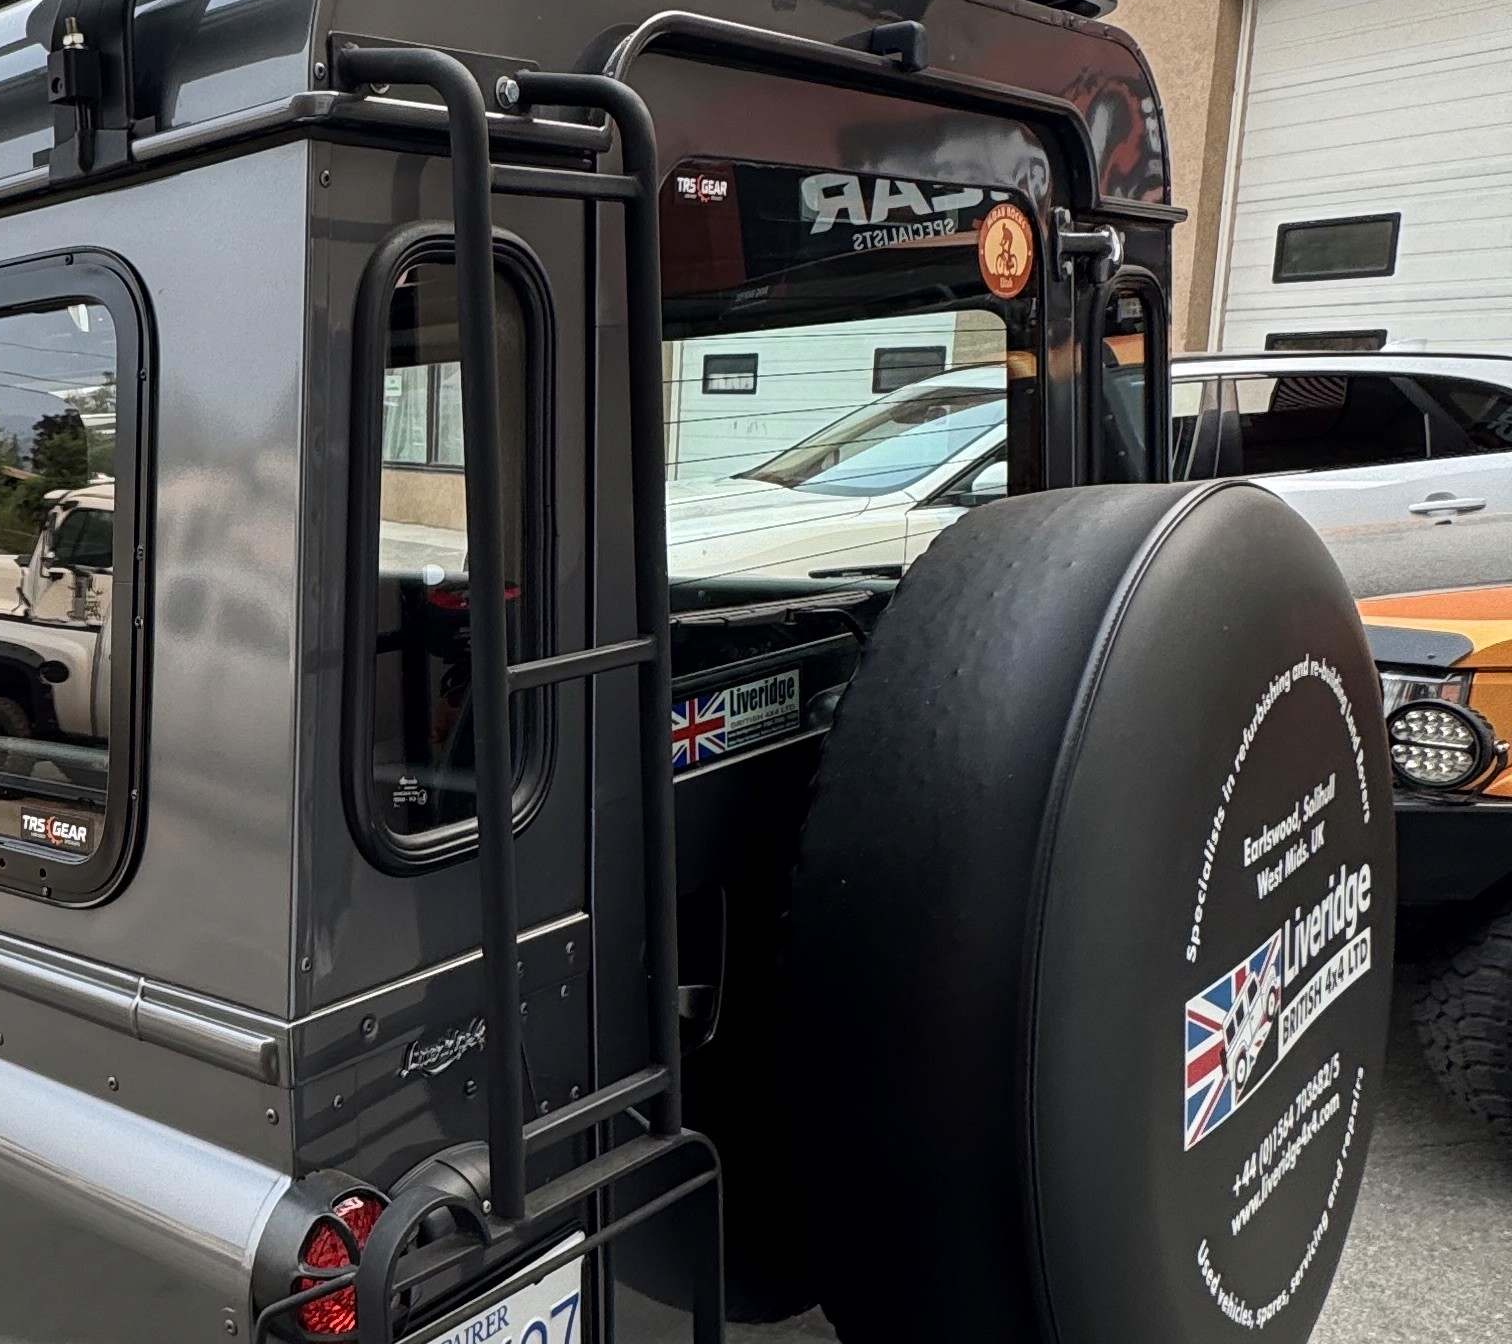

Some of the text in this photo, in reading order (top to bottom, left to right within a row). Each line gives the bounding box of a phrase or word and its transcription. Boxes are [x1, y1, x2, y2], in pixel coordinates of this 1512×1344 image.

[677, 177, 728, 197] TRS GEAR
[729, 676, 795, 716] Liveridge
[22, 814, 87, 843] TRS GEAR
[1186, 806, 1225, 963] Specialists
[1222, 774, 1236, 803] in
[1234, 670, 1292, 773] refurbishing
[1292, 653, 1310, 682] and
[1244, 801, 1302, 868] Earlswood,
[1257, 859, 1284, 900] West
[1311, 820, 1326, 854] UK
[1284, 863, 1372, 988] Liveridge
[1283, 937, 1369, 1047] BRITISH 4x4 LTD
[1232, 1152, 1257, 1197] +44
[1197, 1238, 1222, 1297] Used
[1327, 1158, 1344, 1210] and
